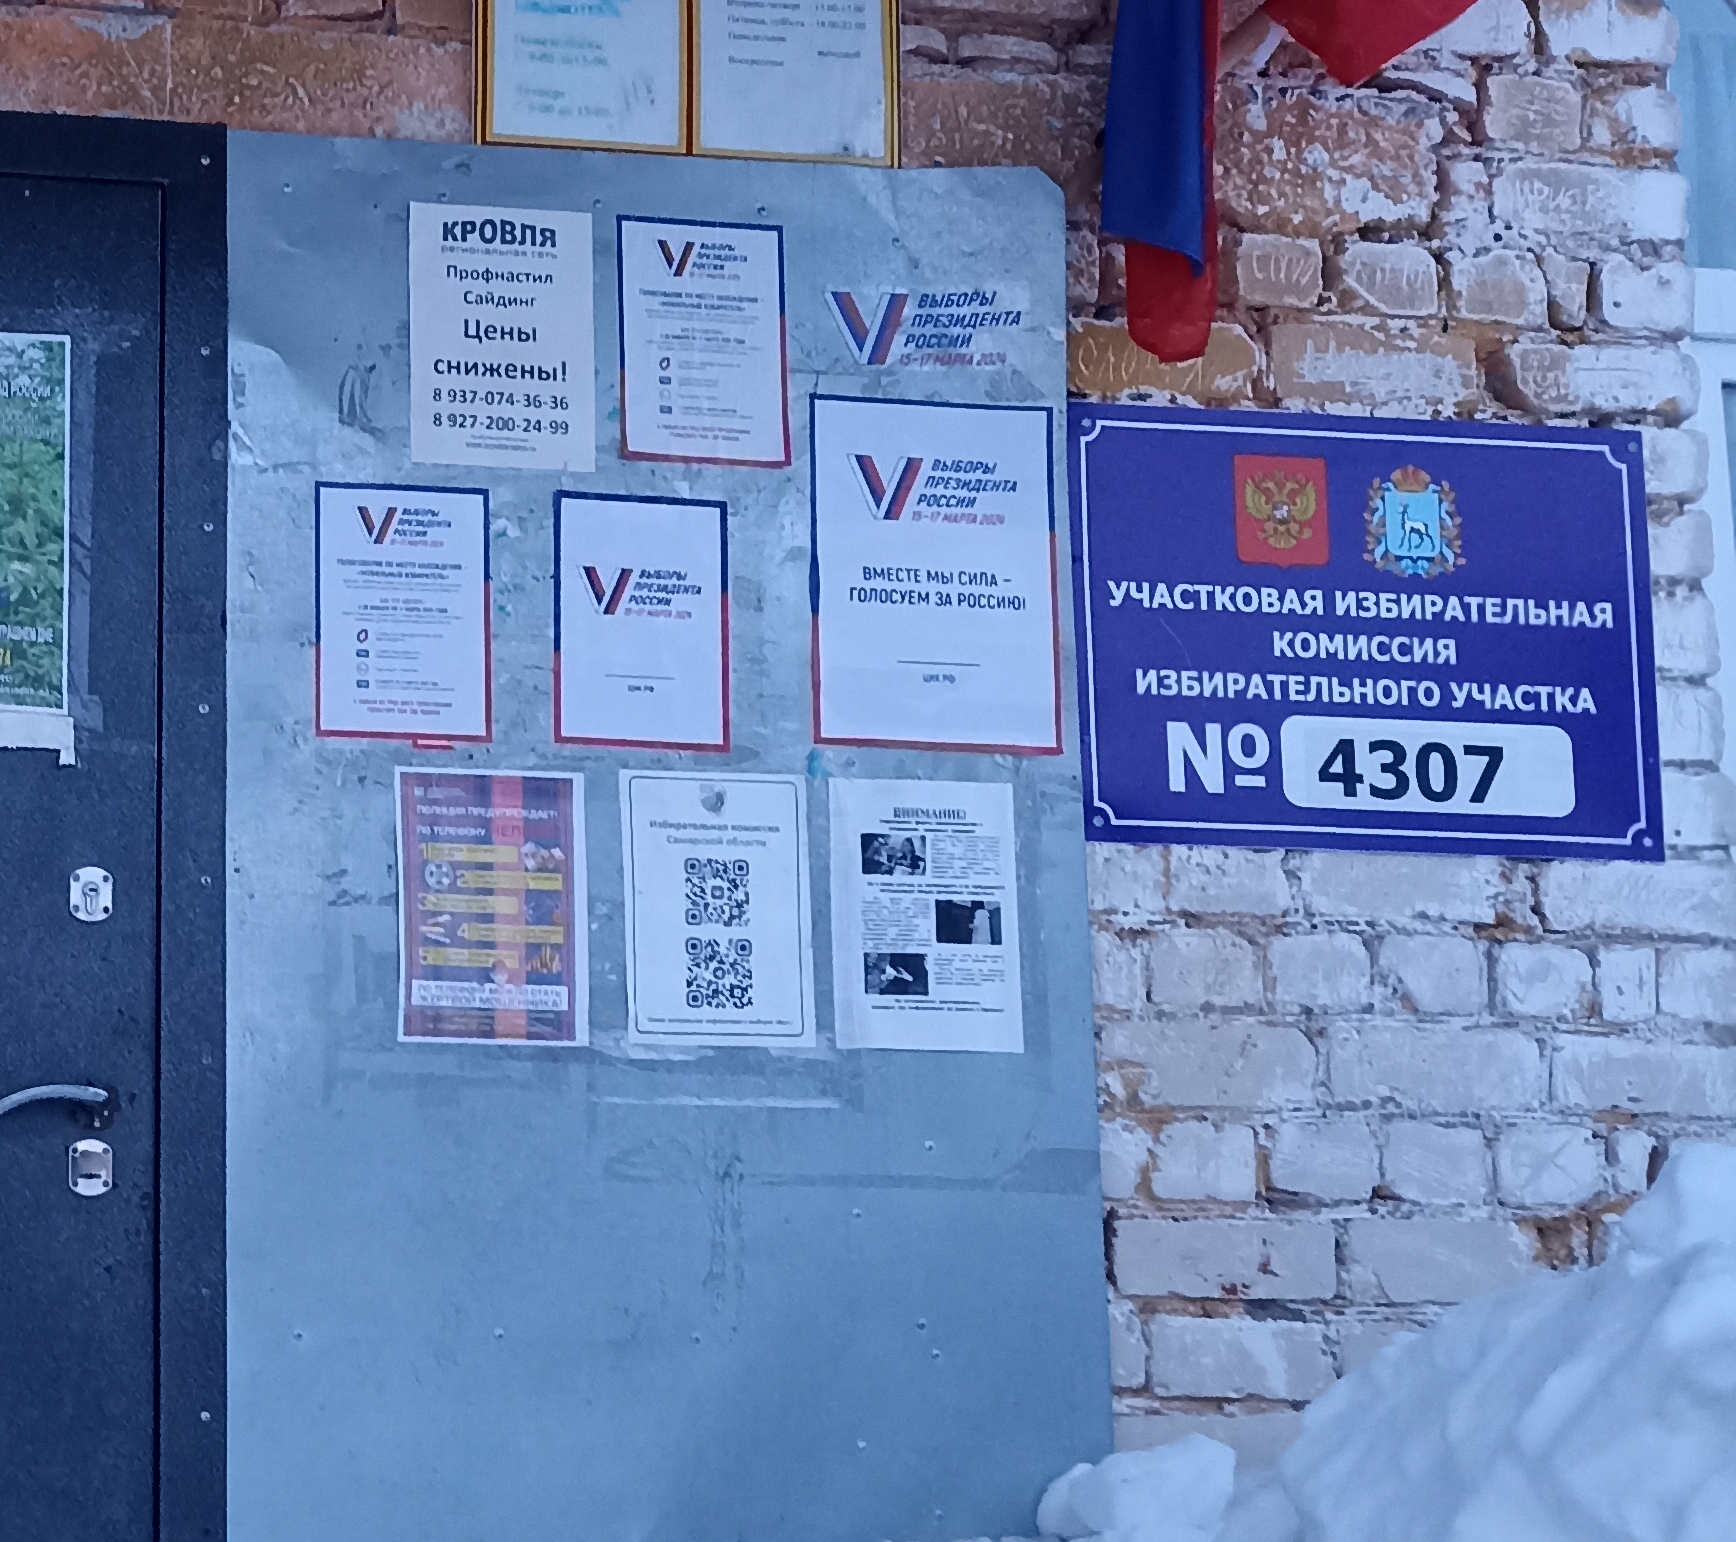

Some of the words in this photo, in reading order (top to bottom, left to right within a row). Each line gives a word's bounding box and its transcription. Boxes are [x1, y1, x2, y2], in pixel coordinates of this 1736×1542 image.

[442, 219, 557, 248] КРОВЛЯ
[446, 264, 553, 284] Профнастил
[463, 290, 537, 308] Сайдинг
[918, 290, 997, 309] ВЫБОРЫ
[463, 318, 537, 344] Цены
[911, 311, 1022, 330] ПРЕЗИДЕНТА
[904, 333, 972, 349] РОССИИ
[433, 358, 567, 382] снижены!
[433, 388, 442, 402] 8
[448, 388, 569, 410] 937-074-36-36
[433, 412, 442, 427] 8
[448, 413, 569, 435] 927-200-24-99
[931, 459, 997, 475] ВЫБОРЫ
[924, 475, 1017, 493] ПРЕЗИДЕНТА
[917, 493, 977, 508] РОССИИ
[863, 566, 921, 584] ВМЕСТЕ
[926, 569, 954, 585] МЫ
[958, 571, 998, 587] СИЛА
[849, 586, 930, 606] ГОЛОСУЕМ
[935, 591, 953, 607] ЗА
[957, 592, 1026, 610] РОССИЮ!
[1107, 580, 1325, 616] УЧАСТКОВАЯ
[1335, 591, 1613, 628] ИЗБИРАТЕЛЬНАЯ
[1272, 630, 1457, 664] КОМИССИЯ
[1135, 669, 1441, 708] ИЗБИРАТЕЛЬНОГО
[1450, 682, 1597, 714] УЧАСТКА
[1318, 739, 1504, 804] 4307
